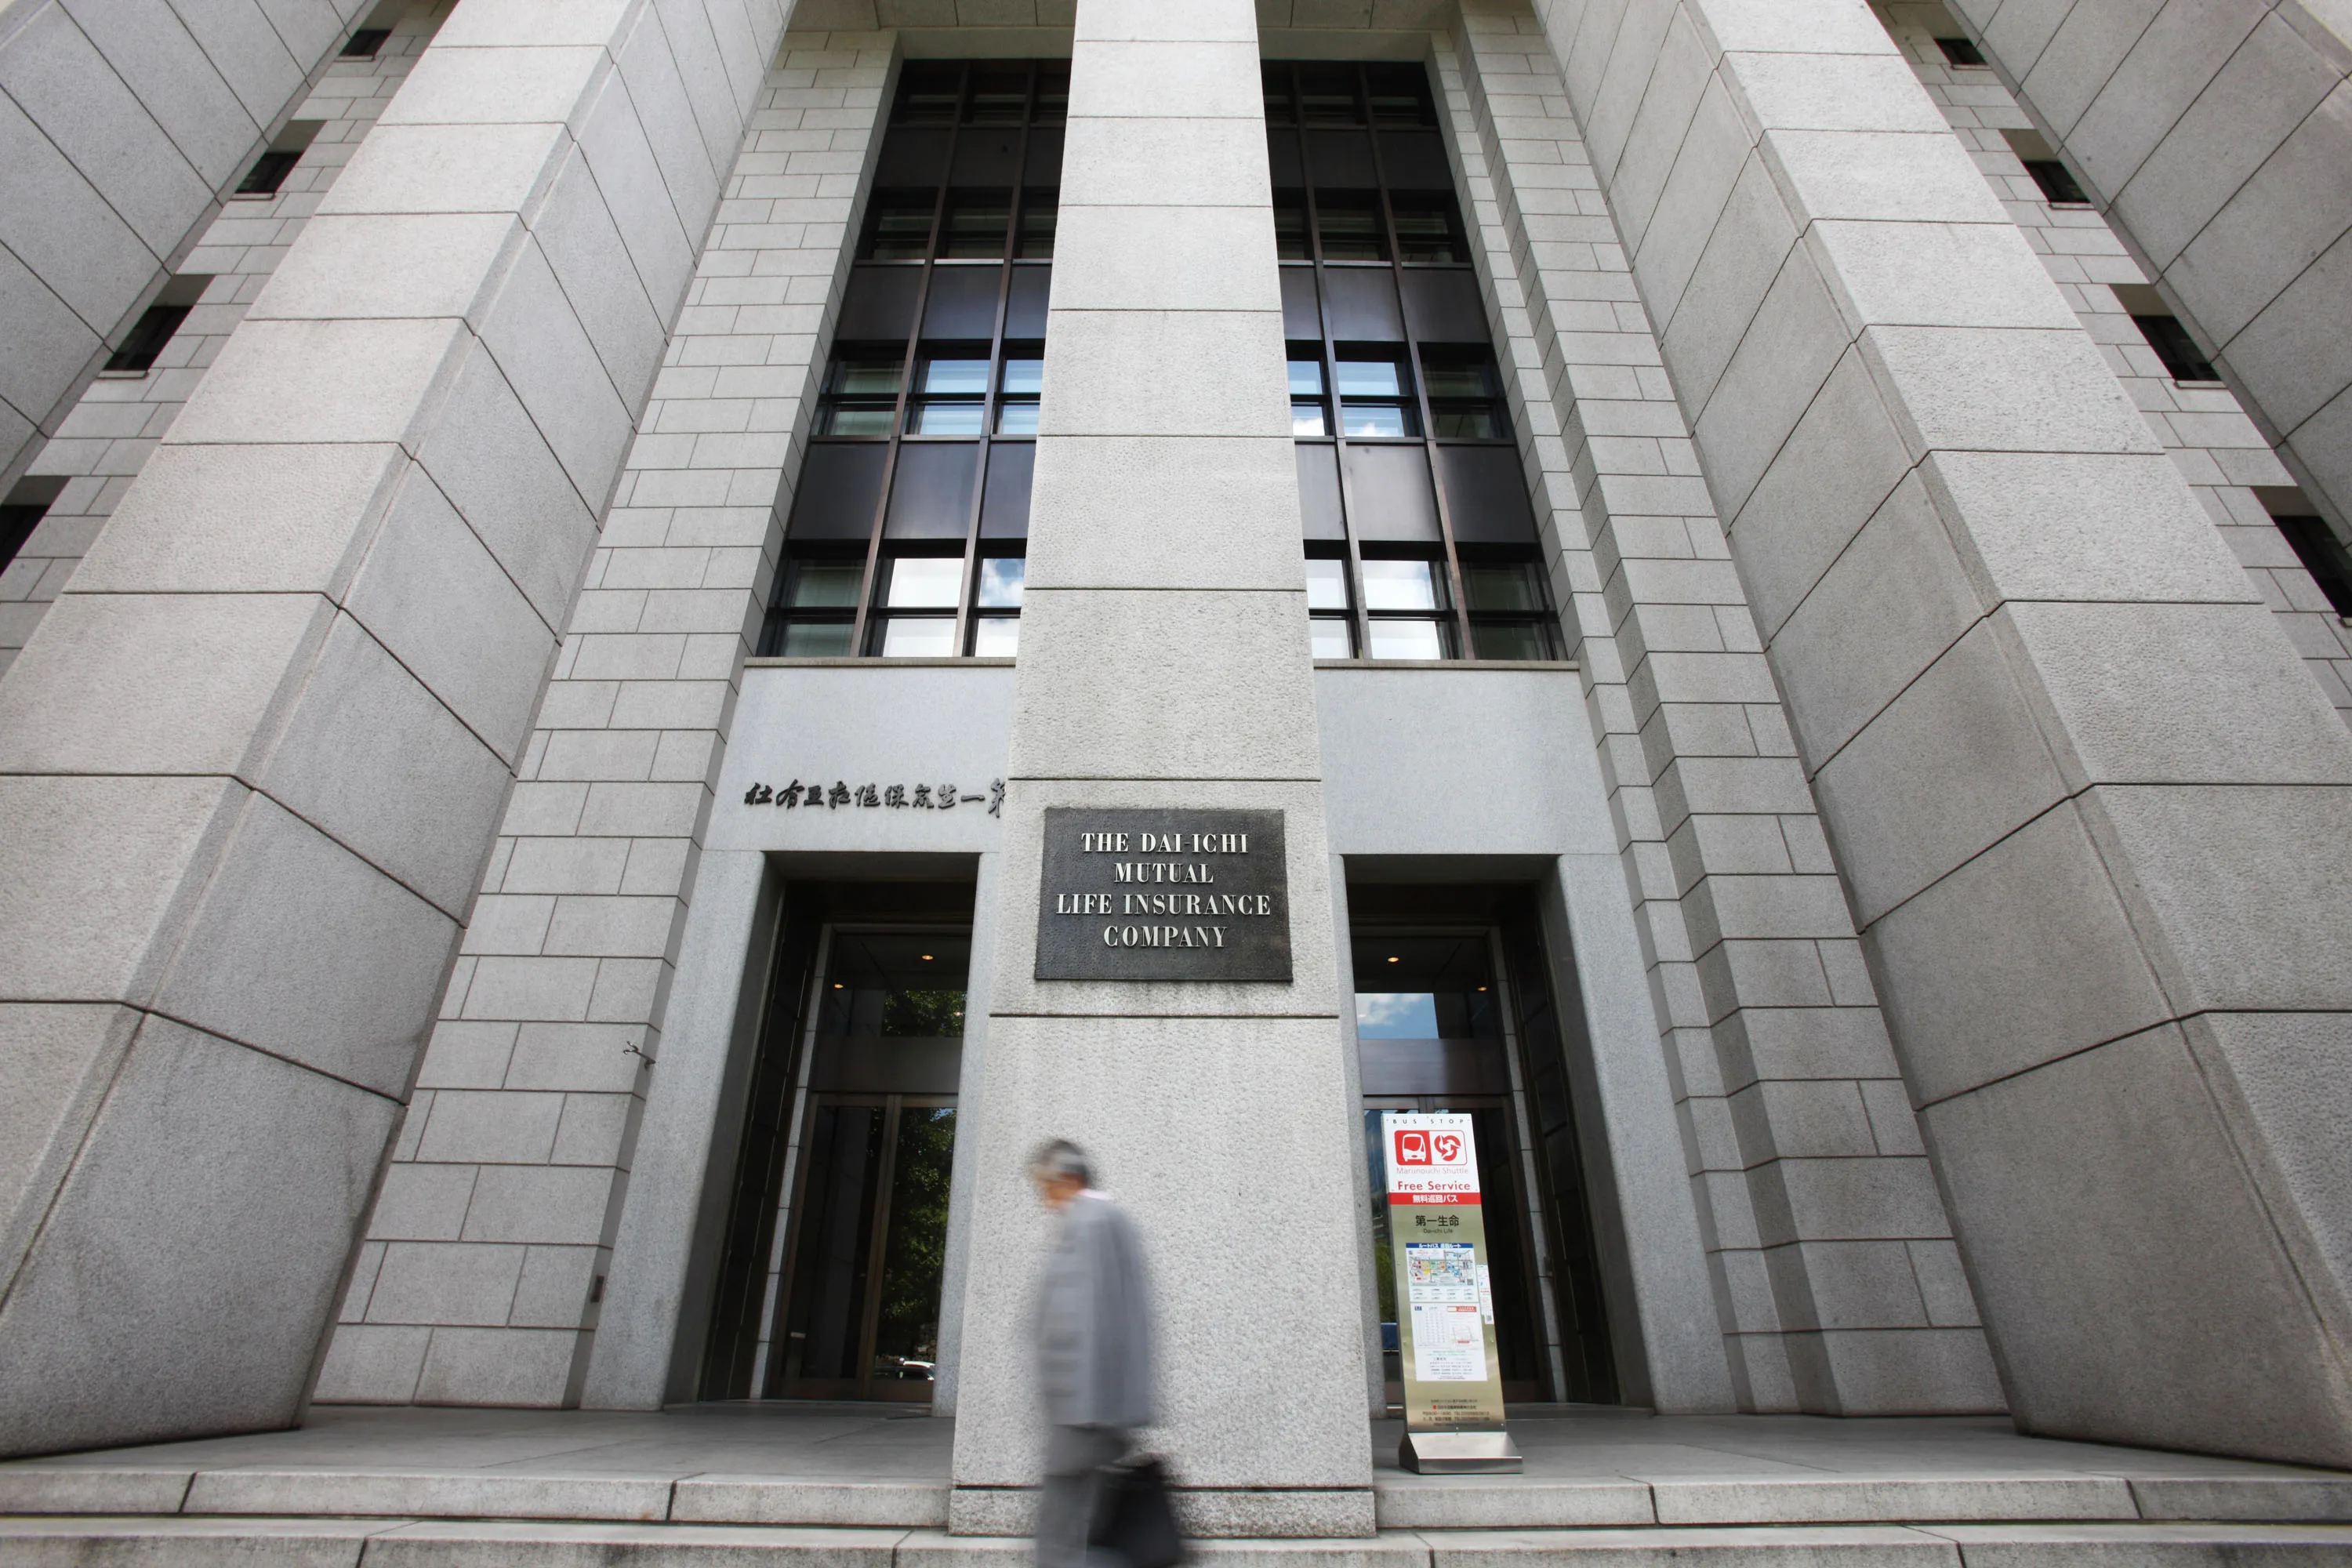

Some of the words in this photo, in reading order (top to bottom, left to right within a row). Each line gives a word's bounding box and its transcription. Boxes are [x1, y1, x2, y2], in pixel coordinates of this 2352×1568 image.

[1081, 833, 1129, 852] THE
[1141, 833, 1249, 854] DAI-ICHI
[1114, 862, 1214, 884] MUTUAL
[1056, 893, 1112, 914] LIFE
[1123, 894, 1271, 916] INSURANCE
[1104, 925, 1228, 947] COMPANY
[1397, 1181, 1423, 1190] Free
[1428, 1180, 1471, 1191] Service
[1413, 1194, 1458, 1203] 無料巡回バス
[1415, 1214, 1460, 1227] 第一生命
